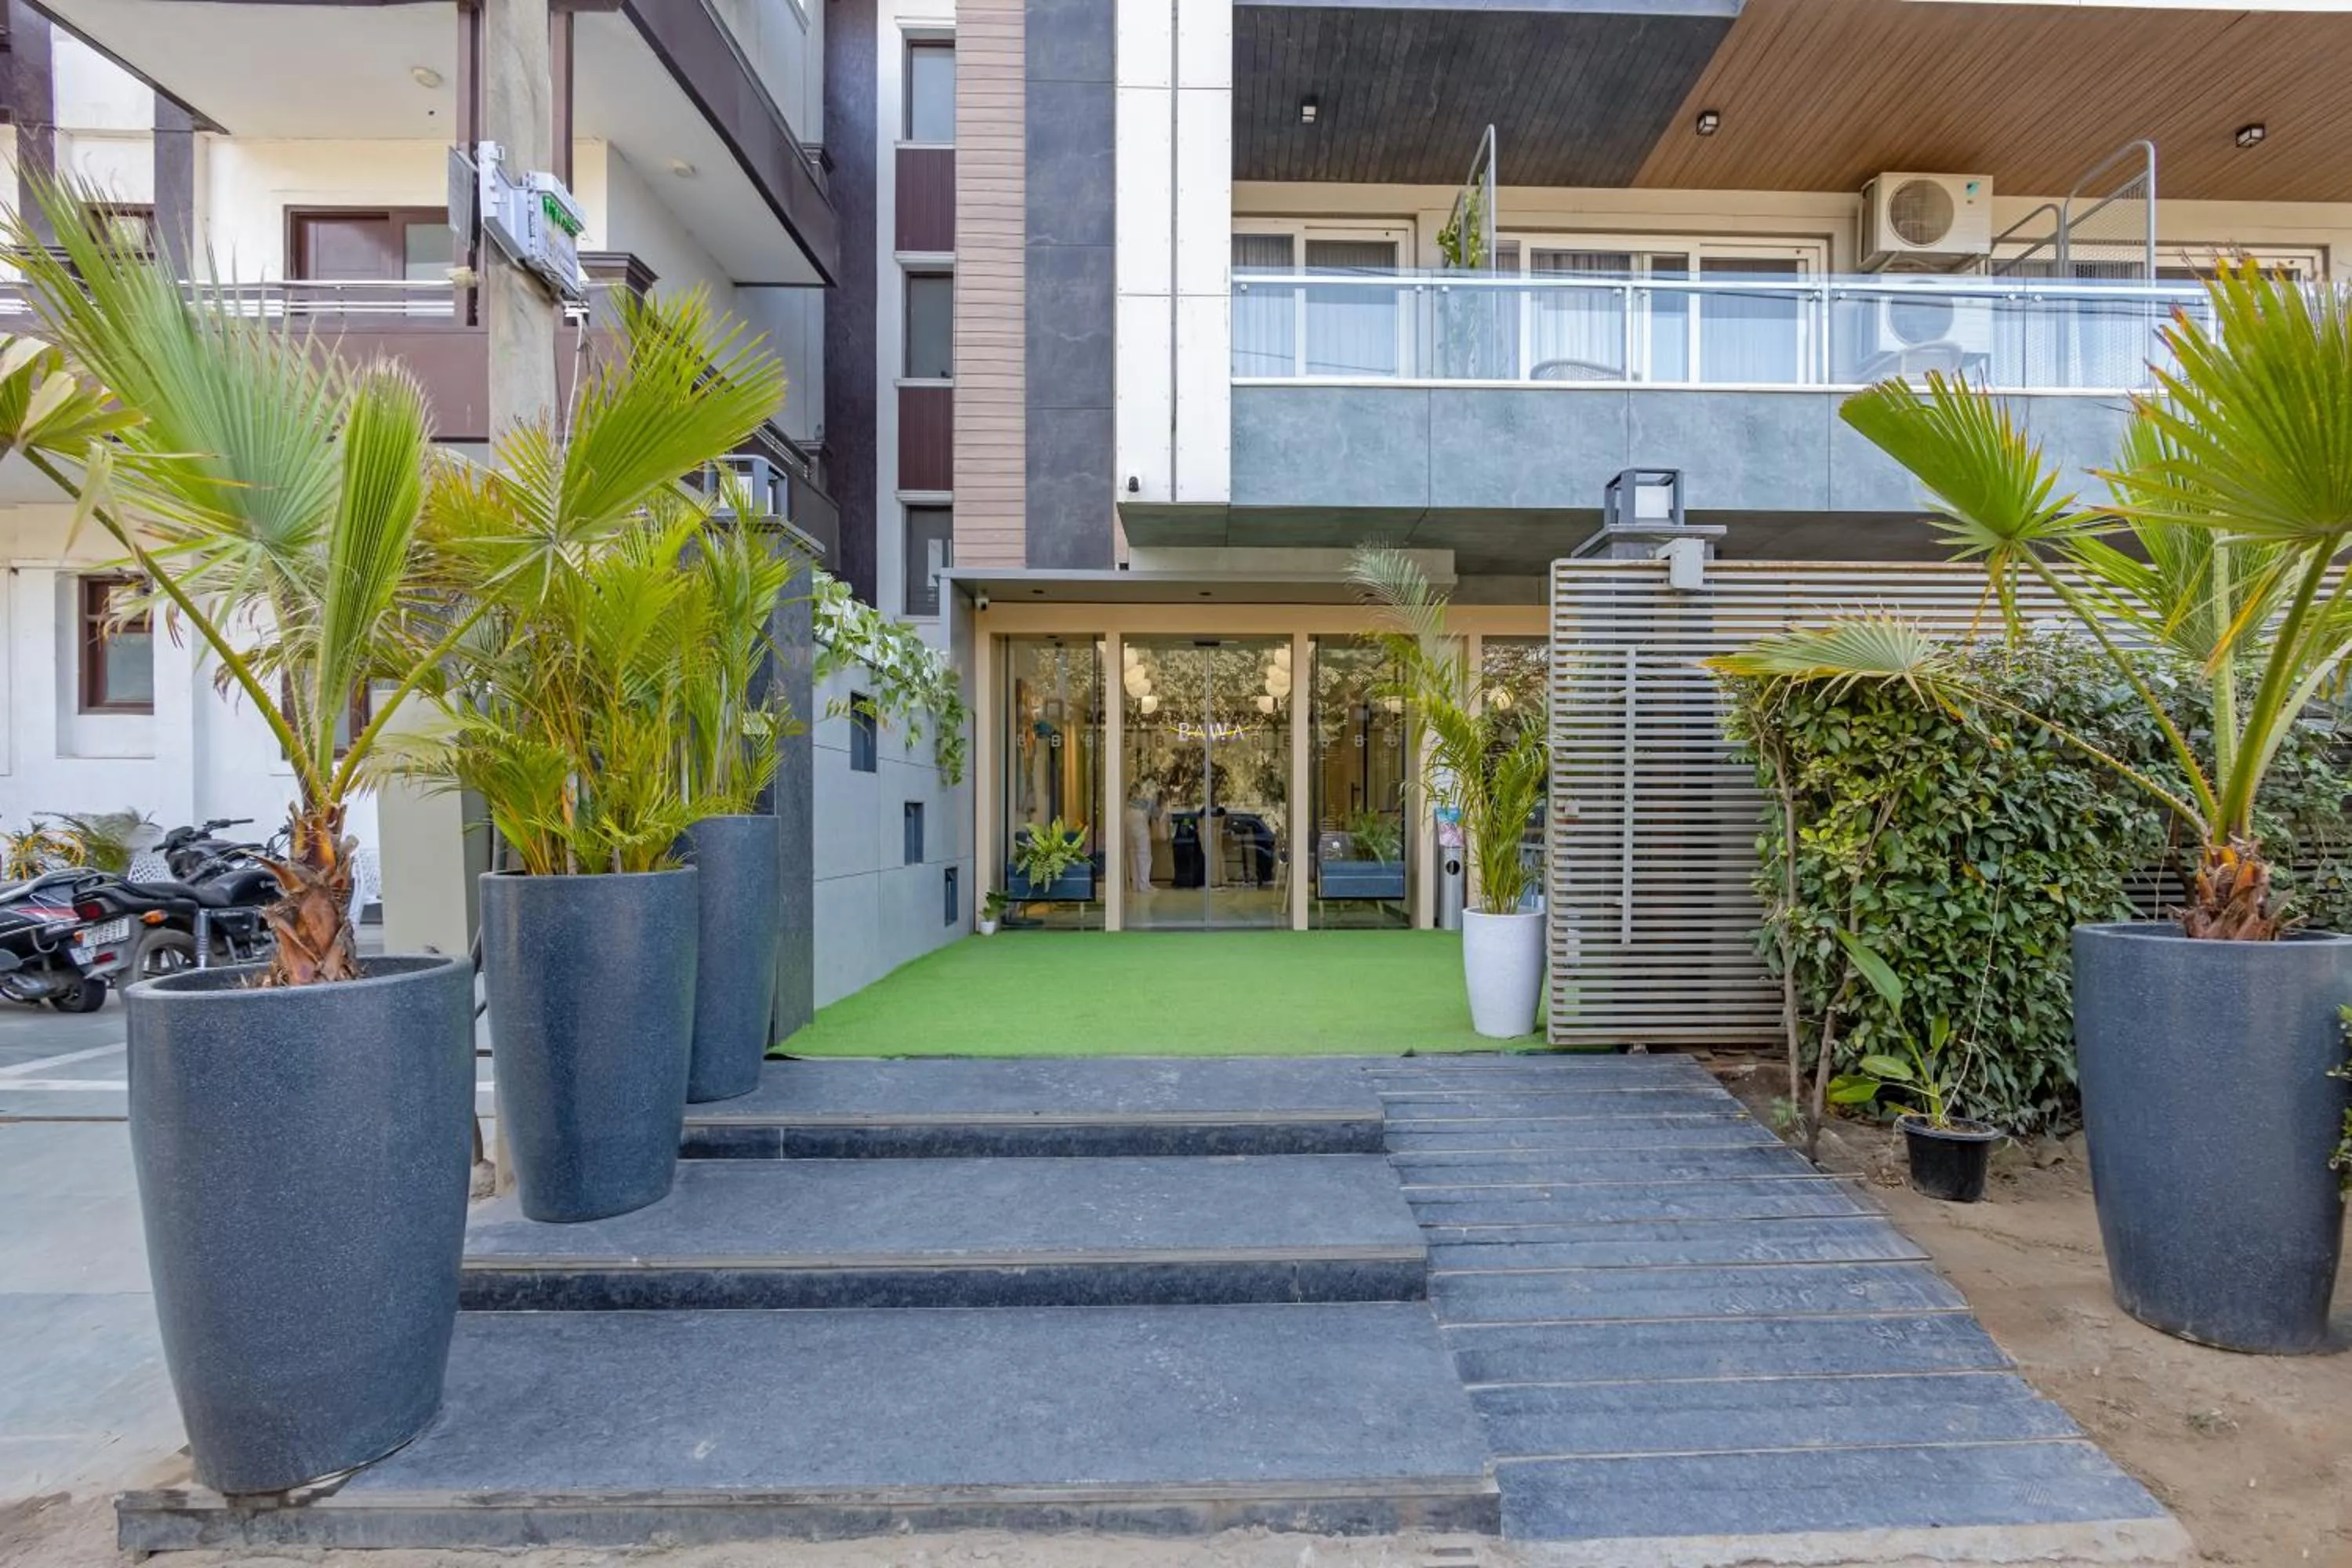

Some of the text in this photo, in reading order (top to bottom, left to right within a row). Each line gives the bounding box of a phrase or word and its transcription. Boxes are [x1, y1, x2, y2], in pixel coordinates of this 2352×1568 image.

[1178, 722, 1245, 741] BAWA
[1051, 735, 1061, 747] B
[1355, 735, 1364, 747] B
